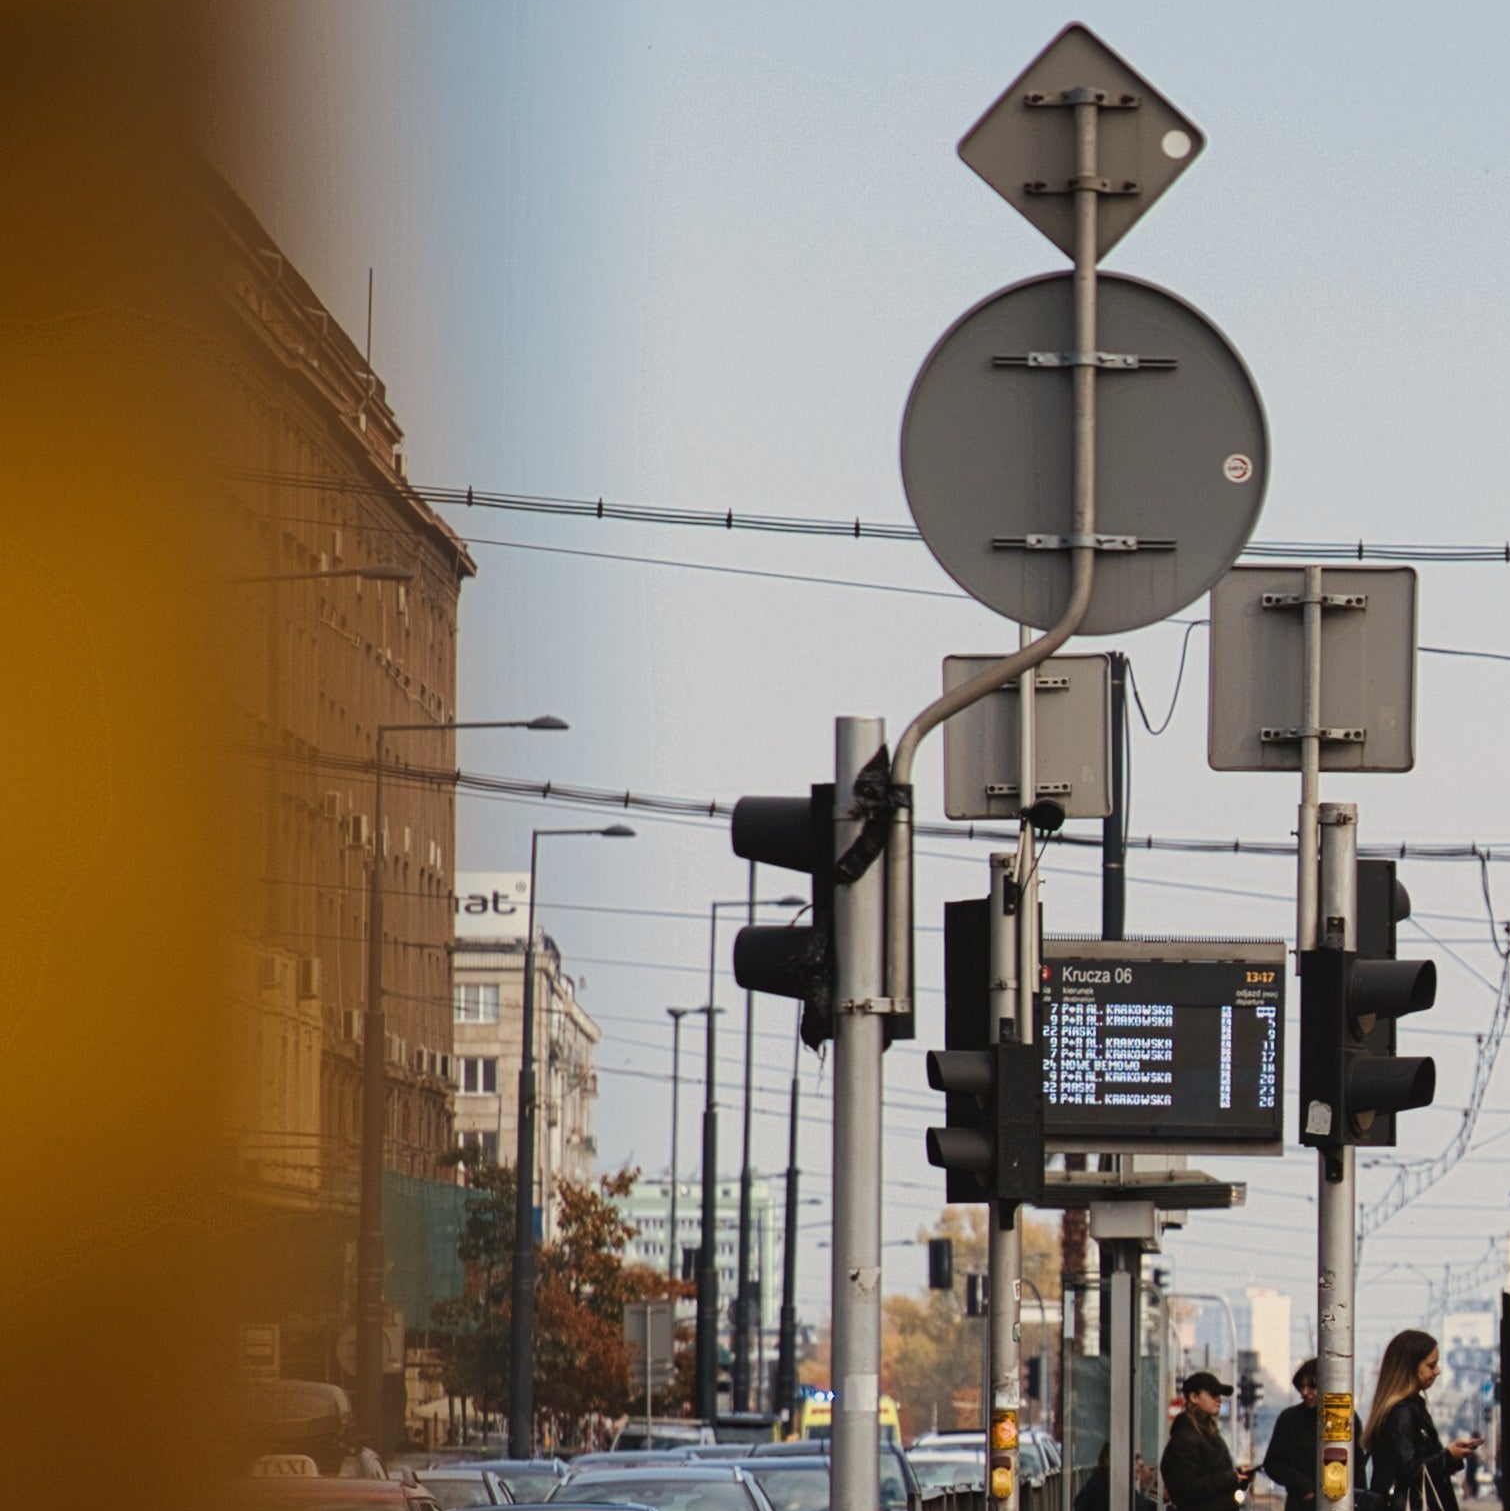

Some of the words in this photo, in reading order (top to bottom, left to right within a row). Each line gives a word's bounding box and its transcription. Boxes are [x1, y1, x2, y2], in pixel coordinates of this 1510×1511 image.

[455, 891, 517, 915] at
[1062, 967, 1110, 983] Krucza
[1115, 968, 1132, 984] 06
[1245, 972, 1275, 983] 13:17
[1050, 1004, 1058, 1014] 7
[1106, 1005, 1173, 1015] KRAKOWSKA
[1050, 1016, 1058, 1026] 9
[1106, 1016, 1173, 1027] KRAKOWSKA
[1042, 1026, 1058, 1036] 22
[1061, 1026, 1096, 1037] PIASKI
[1268, 1029, 1275, 1040] 9
[1050, 1038, 1057, 1048] 9
[1106, 1038, 1173, 1049] KRAKOWSKA
[1262, 1041, 1275, 1050] 11
[1050, 1049, 1057, 1059] 7
[1106, 1050, 1172, 1060] KRAKOWSKA
[1261, 1052, 1275, 1062] 17
[1042, 1060, 1057, 1070] 24
[1061, 1060, 1091, 1070] NOWE
[1094, 1060, 1140, 1071] BEMOWO
[1262, 1063, 1275, 1073] 18
[1050, 1072, 1057, 1082] 9
[1105, 1072, 1172, 1083] KRAKOWSKA
[1259, 1074, 1275, 1084] 20
[1042, 1082, 1057, 1092] 22
[1061, 1082, 1096, 1093] PIASKI
[1259, 1086, 1275, 1096] 23
[1050, 1094, 1057, 1105] 9
[1105, 1095, 1172, 1106] KRAKOWSKA
[1259, 1097, 1275, 1107] 26
[257, 1459, 308, 1475] TAXI
